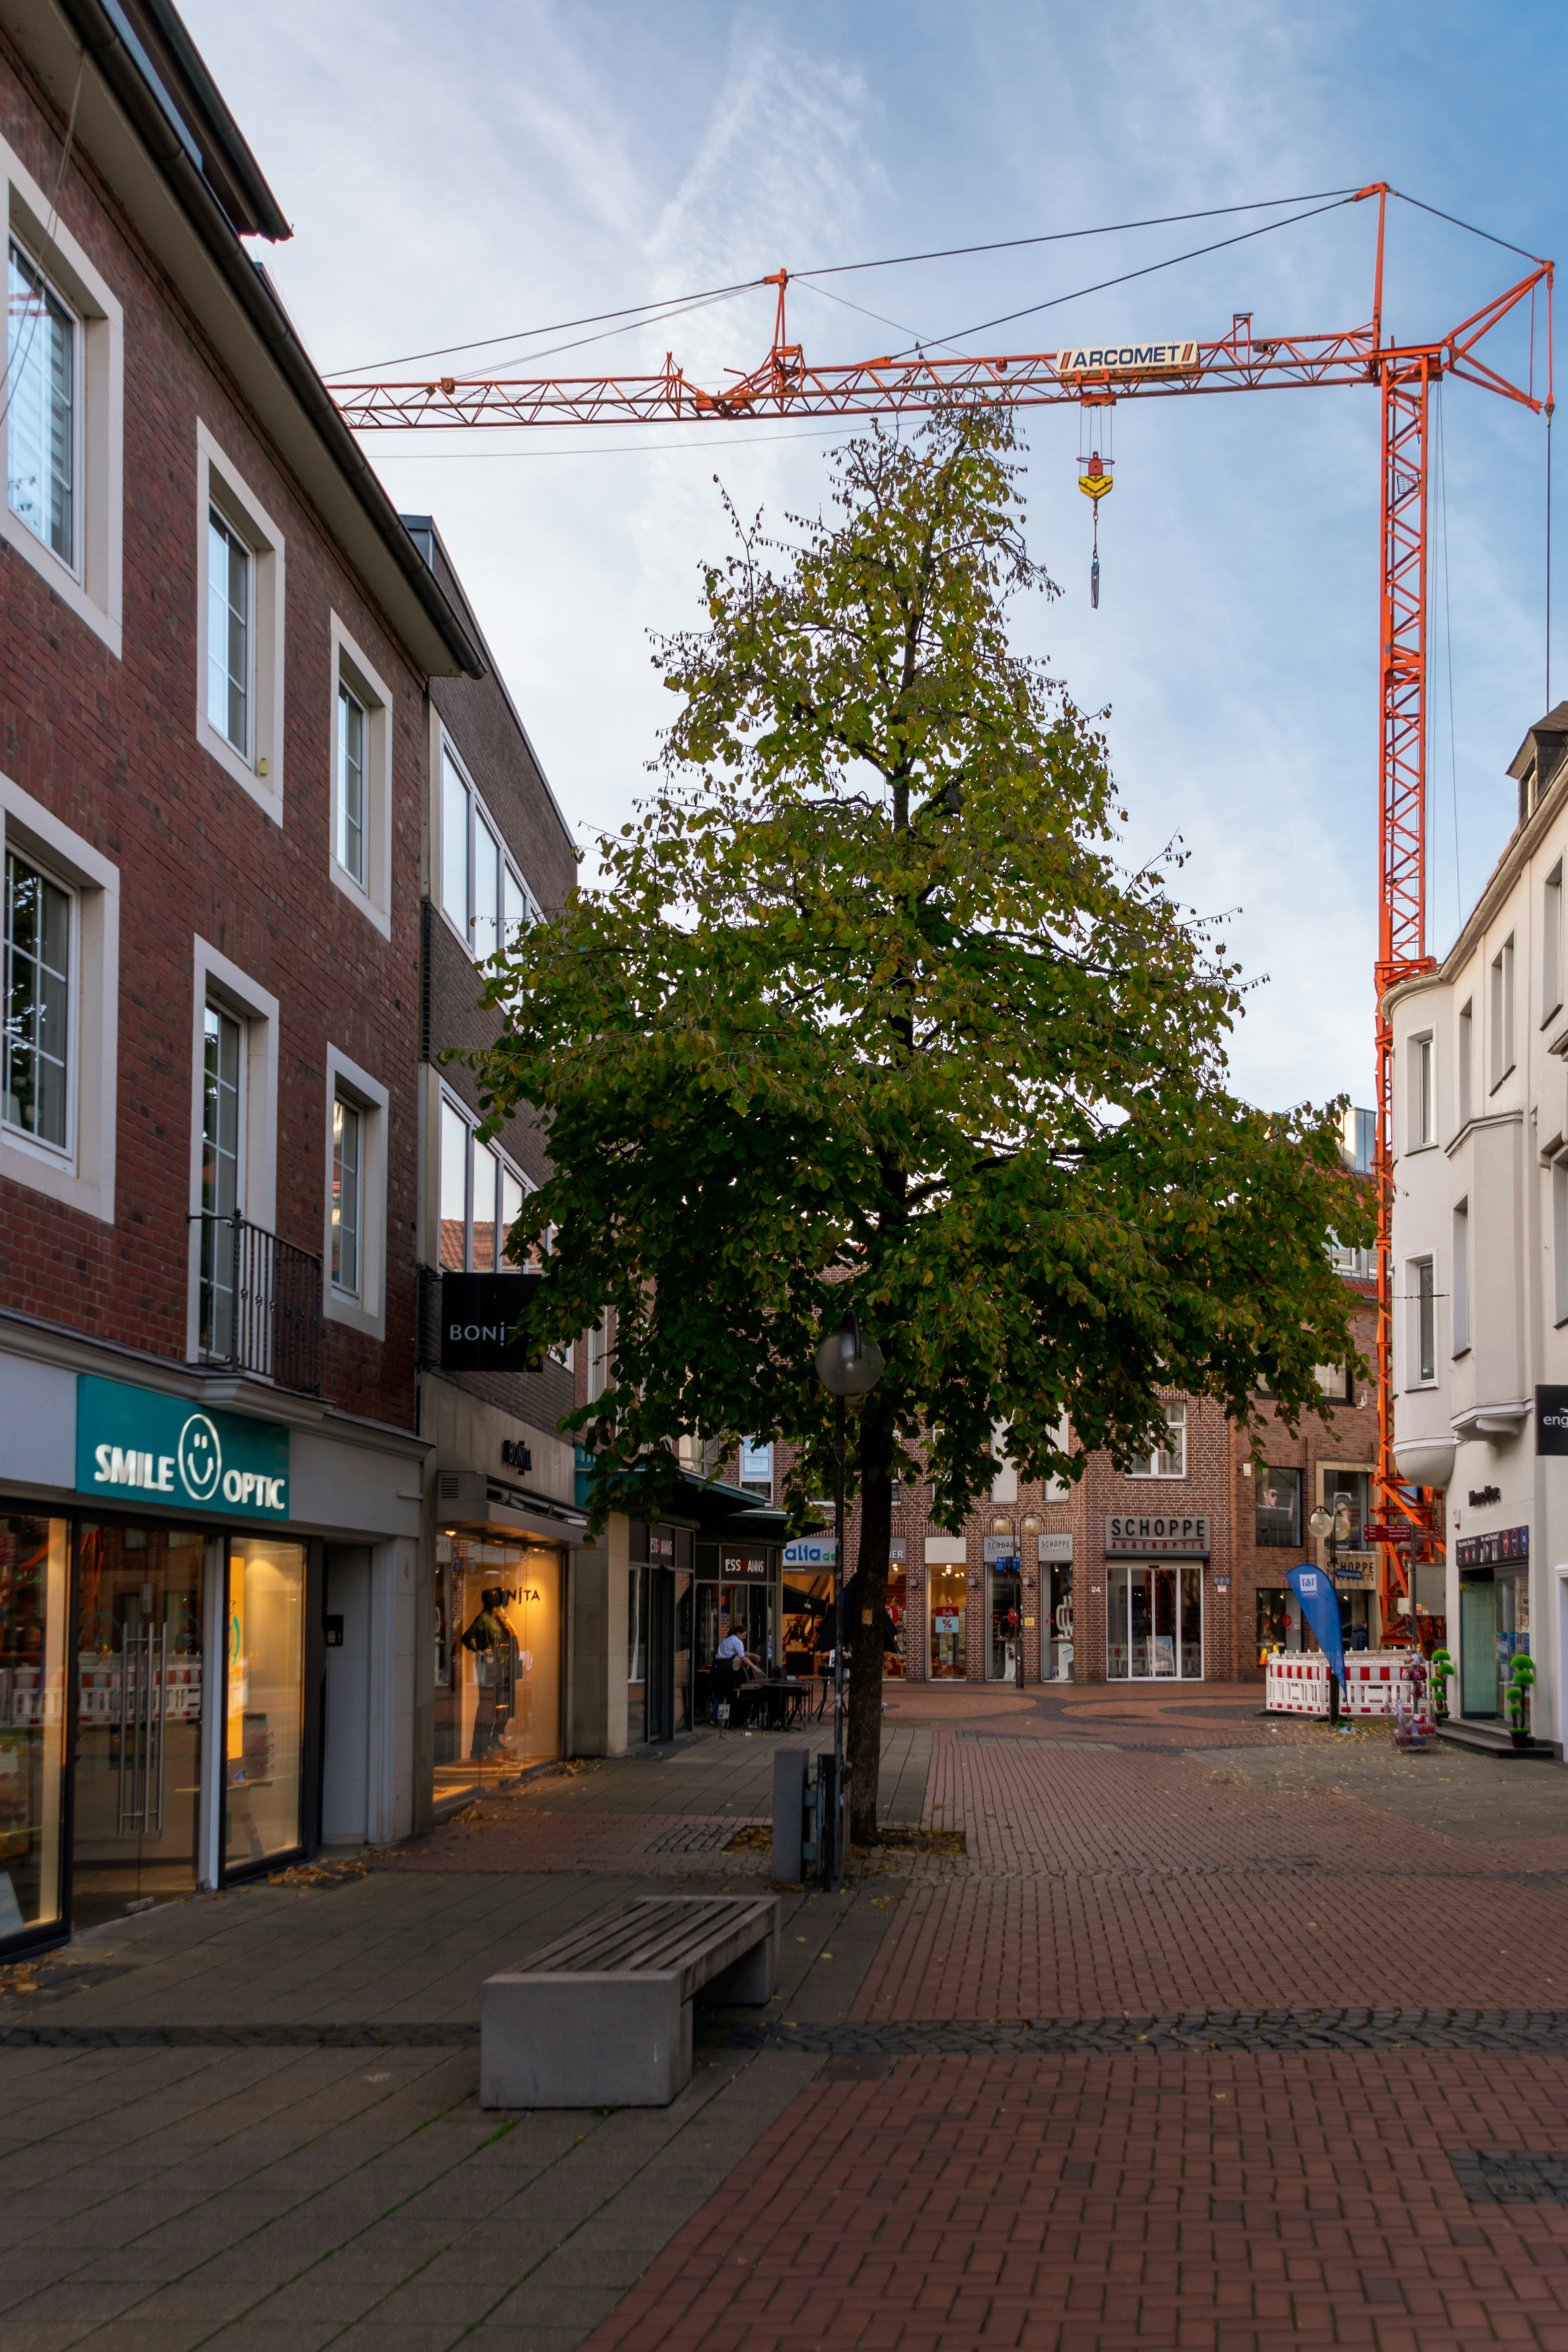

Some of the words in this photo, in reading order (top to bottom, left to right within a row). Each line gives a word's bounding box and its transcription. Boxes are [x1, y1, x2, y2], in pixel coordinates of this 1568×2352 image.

[1073, 345, 1180, 368] ARCOMET
[94, 1444, 175, 1492] SMILE
[223, 1470, 285, 1509] OPTIC
[1112, 1519, 1205, 1536] SCHOPPE
[725, 1559, 764, 1573] ESSMANNS
[942, 1619, 952, 1628] %
